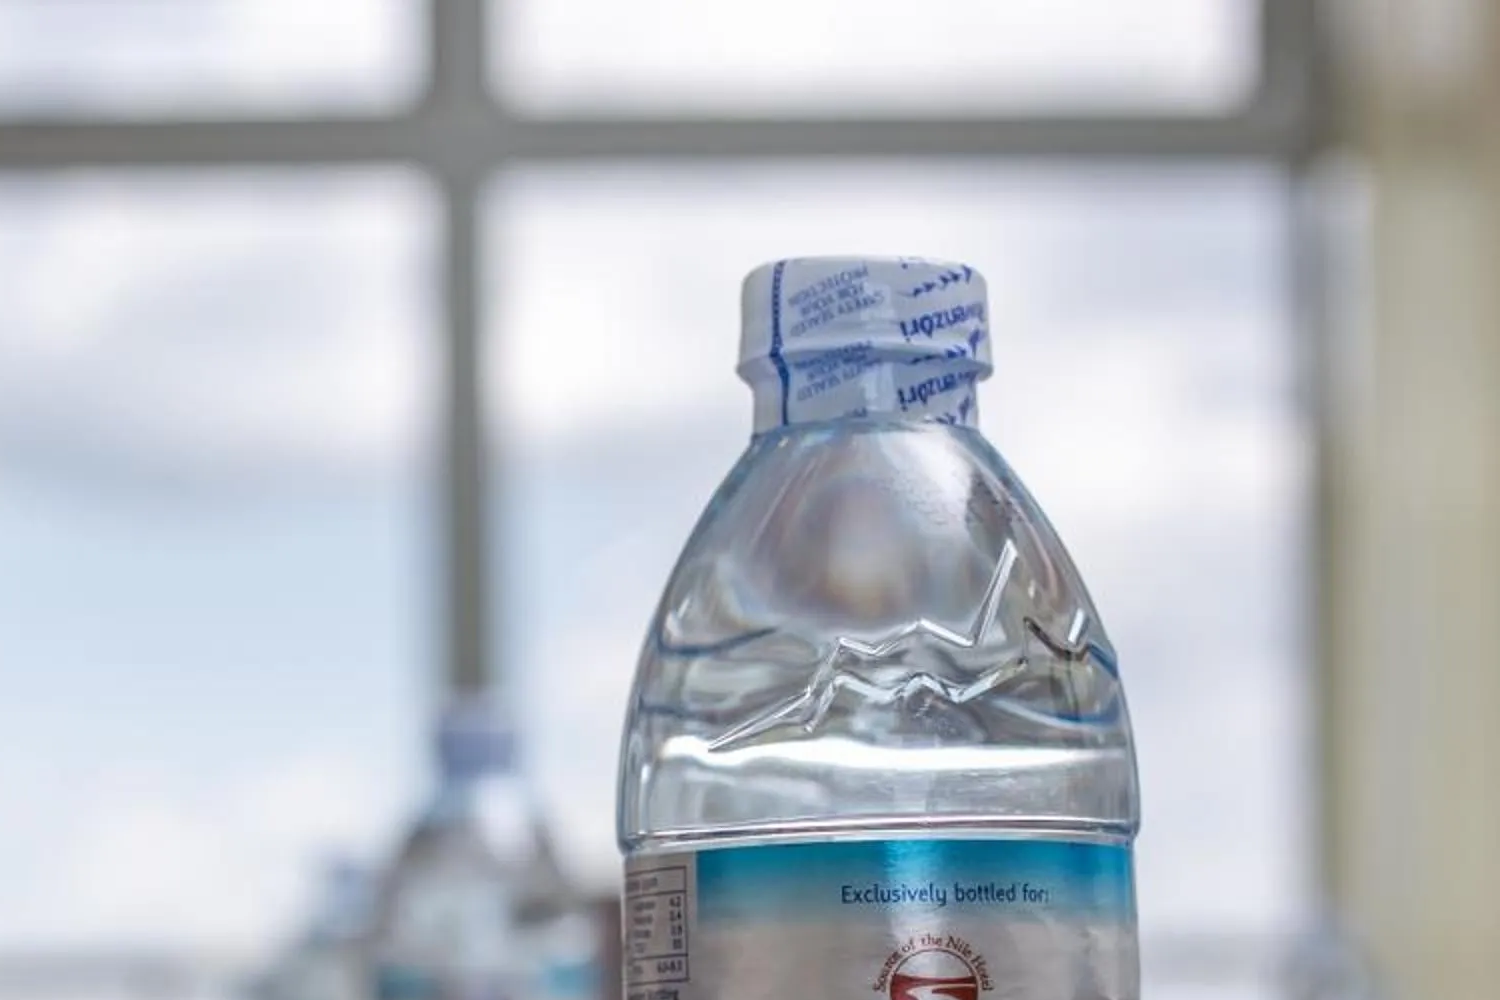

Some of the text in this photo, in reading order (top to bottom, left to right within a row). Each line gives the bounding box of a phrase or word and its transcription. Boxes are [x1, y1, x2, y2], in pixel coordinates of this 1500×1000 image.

[841, 883, 947, 907] Exclusively
[955, 882, 1017, 902] bottled
[872, 933, 994, 992] Source of the Nile Hotel
